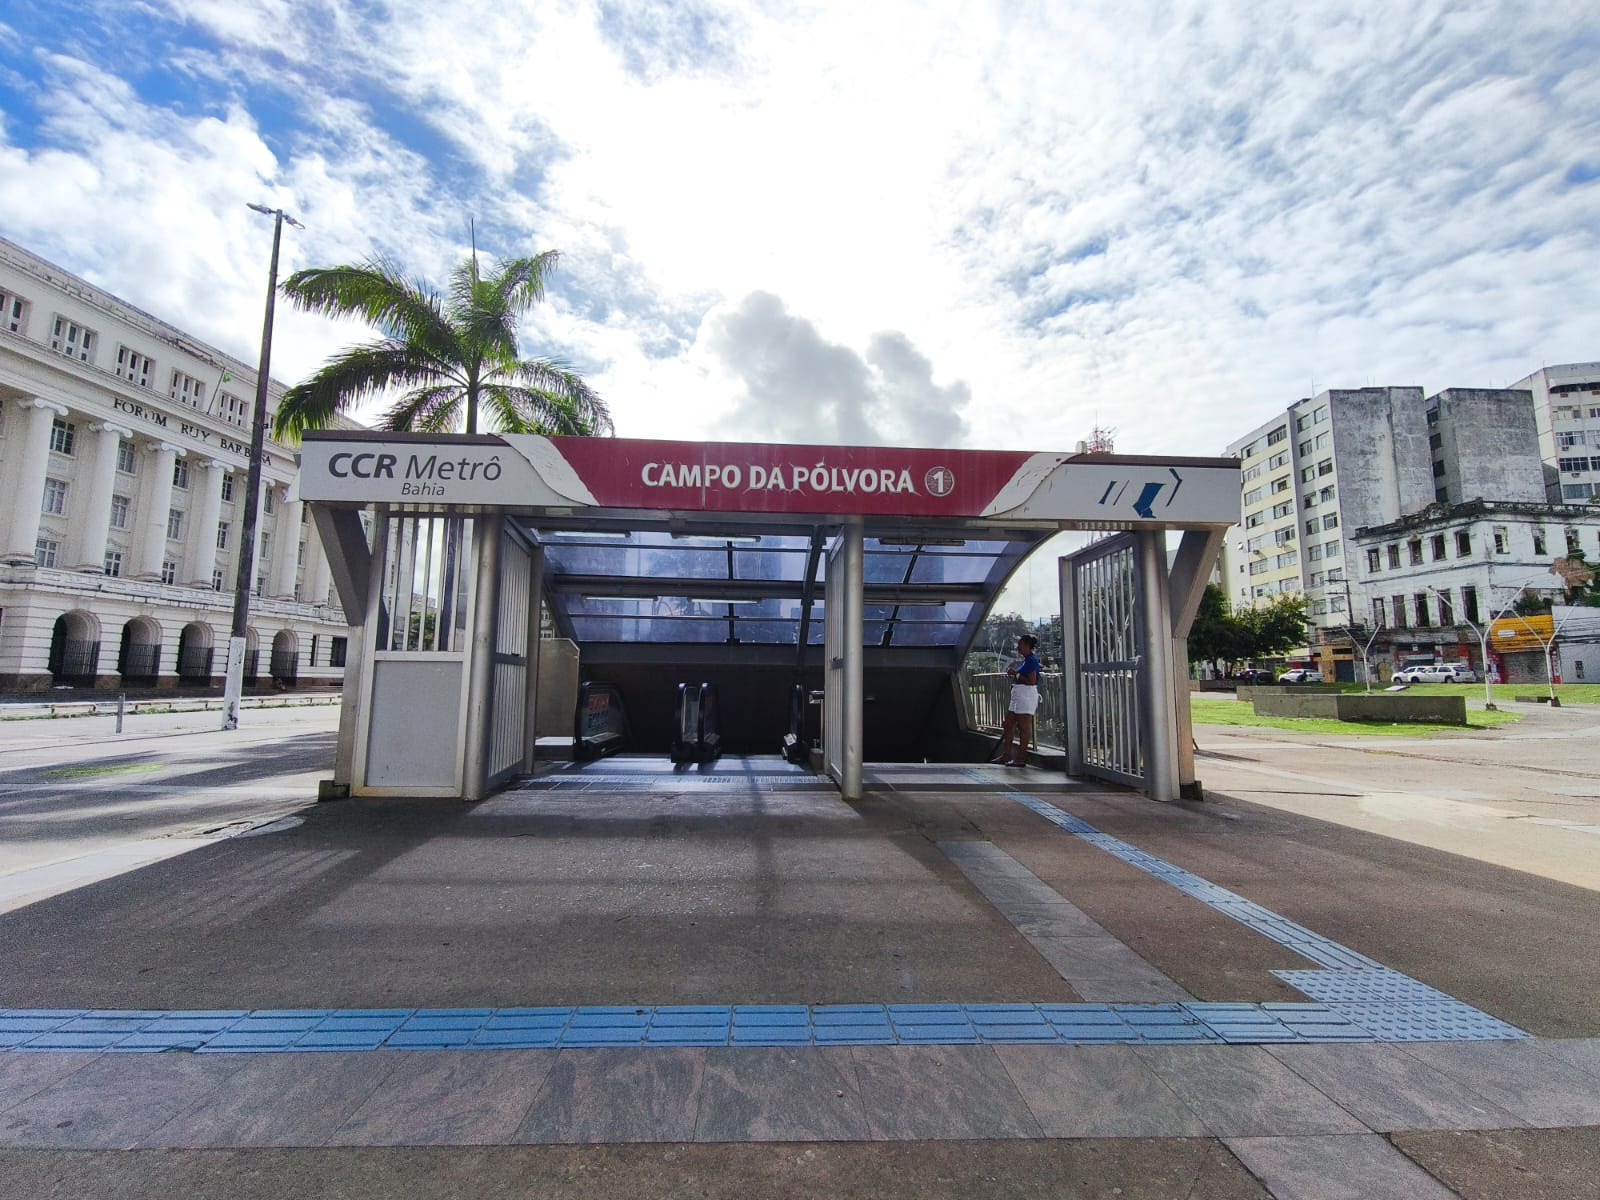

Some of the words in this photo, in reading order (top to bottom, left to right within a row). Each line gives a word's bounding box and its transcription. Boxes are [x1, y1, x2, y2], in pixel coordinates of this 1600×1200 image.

[113, 398, 167, 427] FORUM
[181, 423, 211, 442] RUY
[220, 438, 272, 466] BARBSA
[328, 452, 397, 478] CCR
[405, 454, 502, 481] Metrô
[641, 463, 741, 489] CAMPO
[750, 465, 785, 490] DA
[793, 461, 914, 493] PÓLVORA
[401, 482, 445, 496] Bahia
